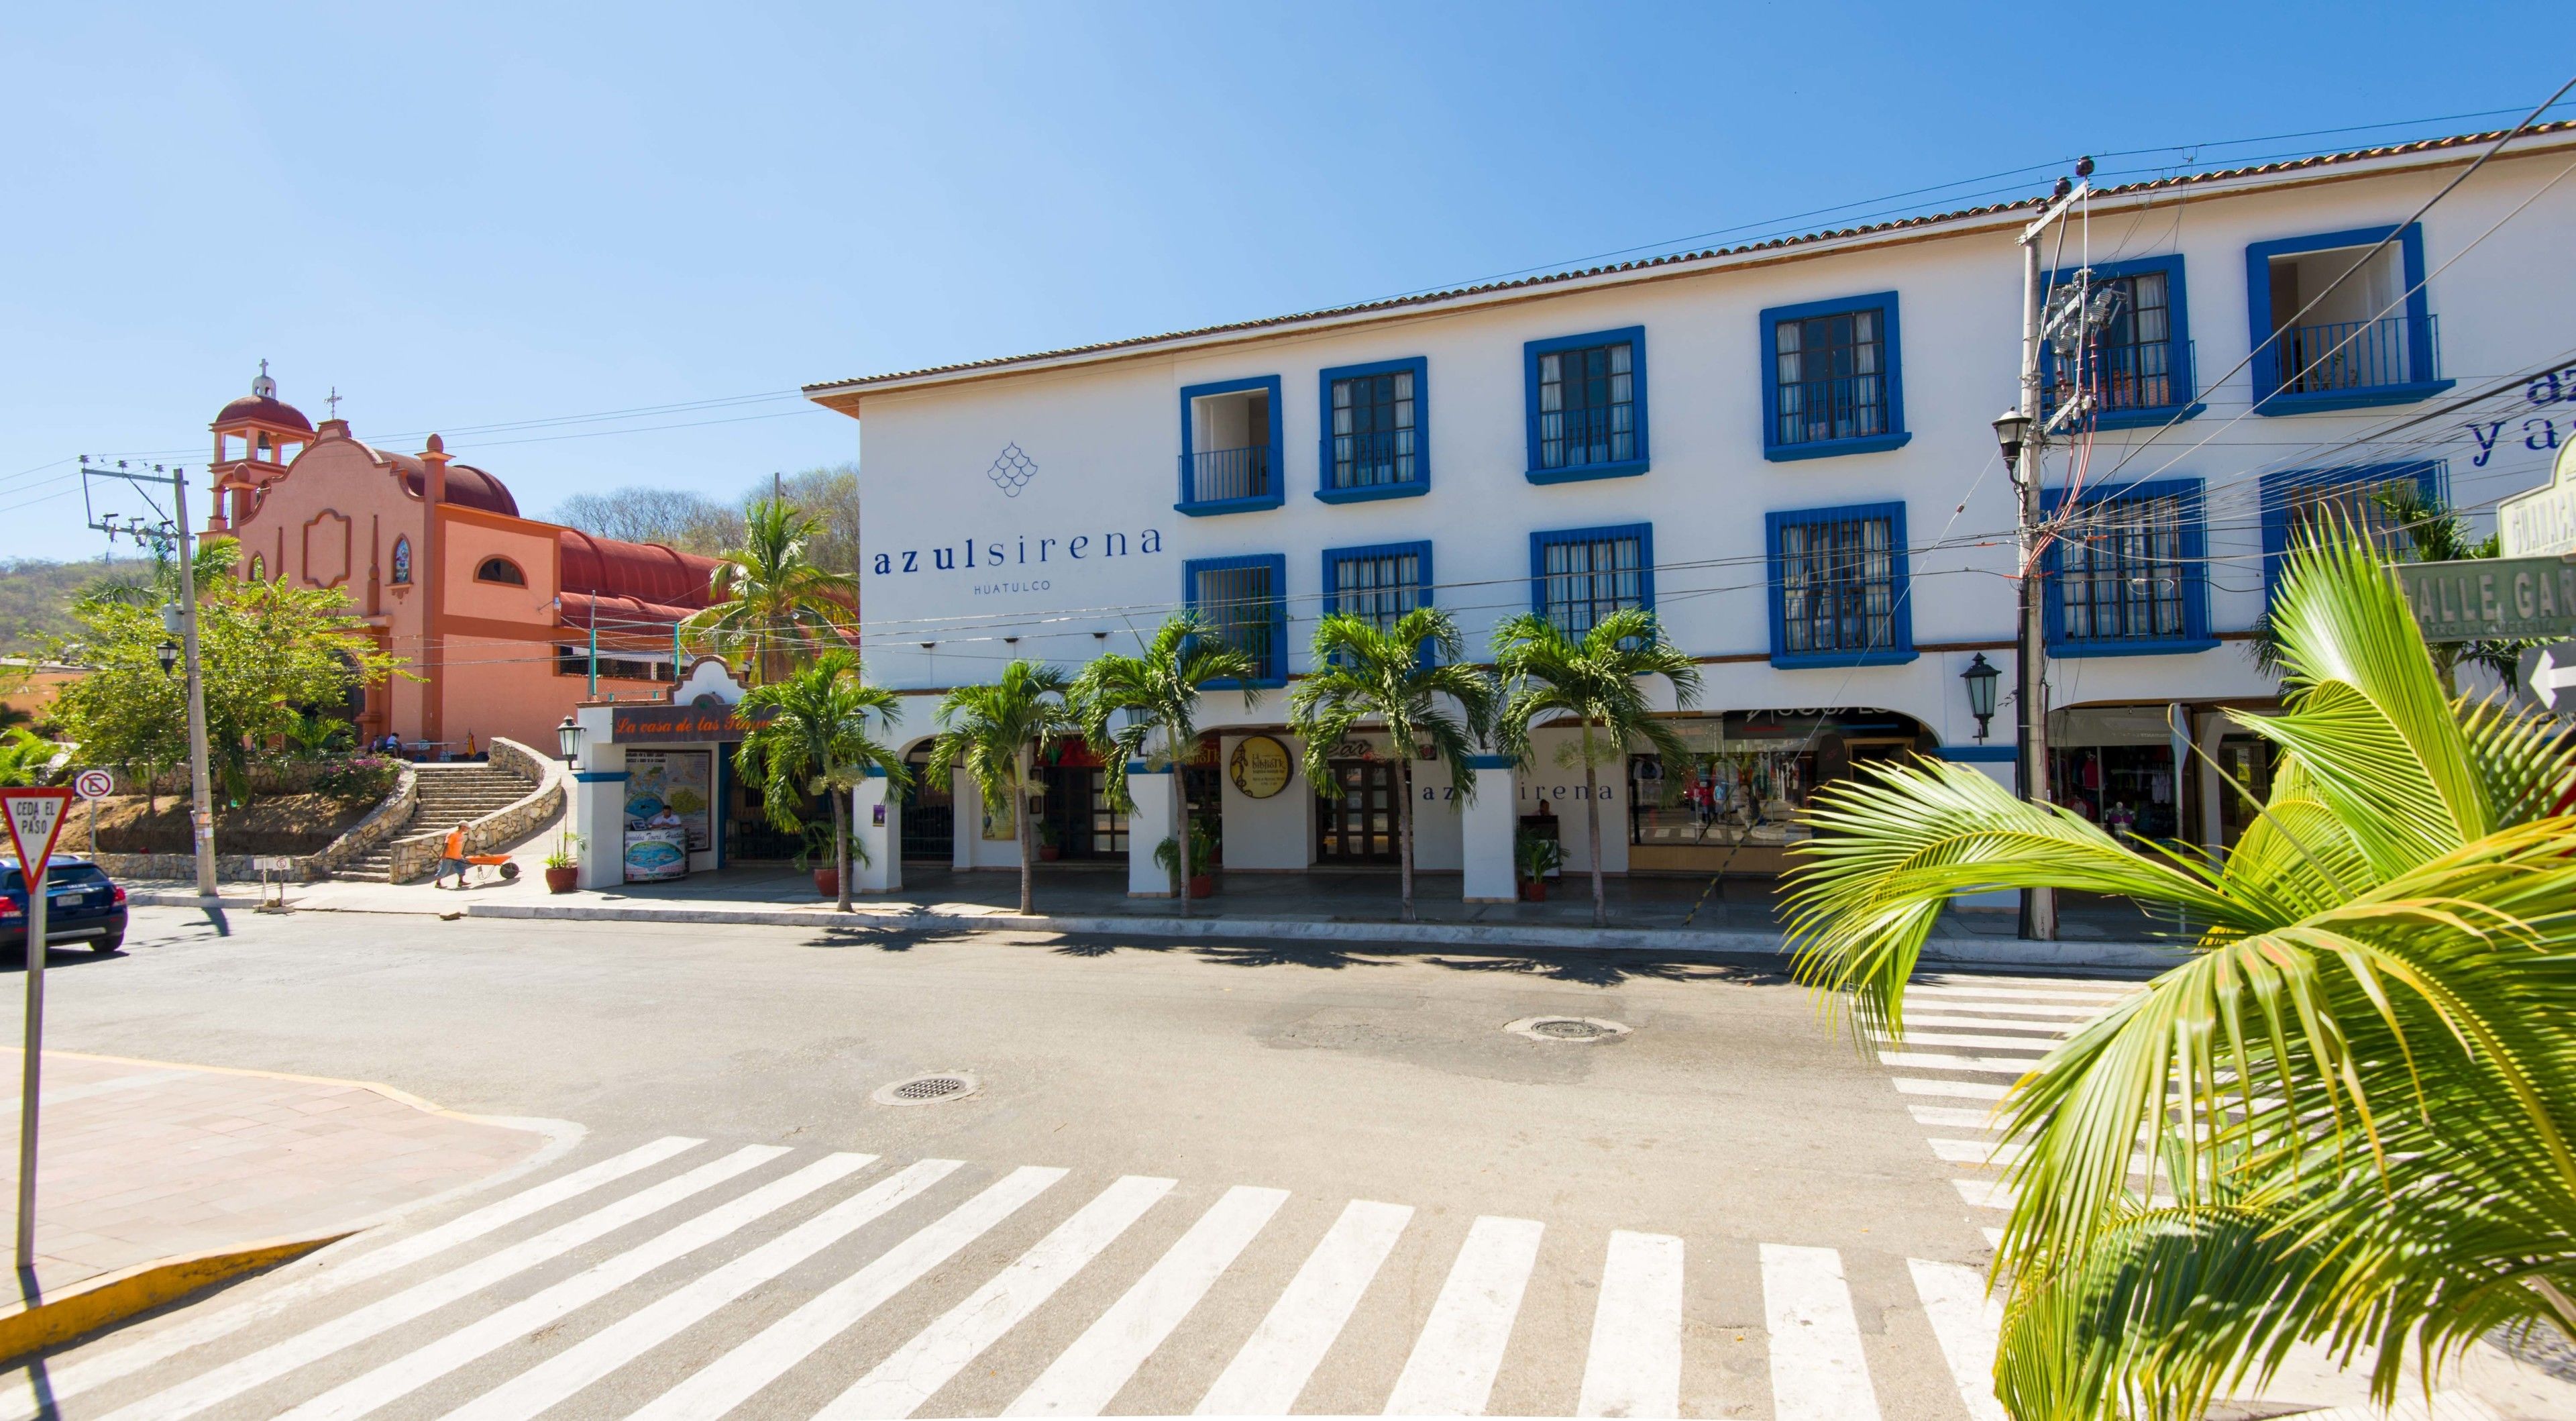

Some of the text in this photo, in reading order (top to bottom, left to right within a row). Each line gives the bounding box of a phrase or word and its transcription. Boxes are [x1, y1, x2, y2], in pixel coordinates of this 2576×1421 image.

[874, 528, 1162, 575] azulsirena
[974, 580, 1051, 595] HUATULCO
[616, 717, 635, 734] La
[639, 721, 671, 733] casa
[676, 717, 692, 732] de
[698, 716, 719, 731] las
[17, 801, 55, 816] CEDA EL
[21, 820, 47, 834] PASO
